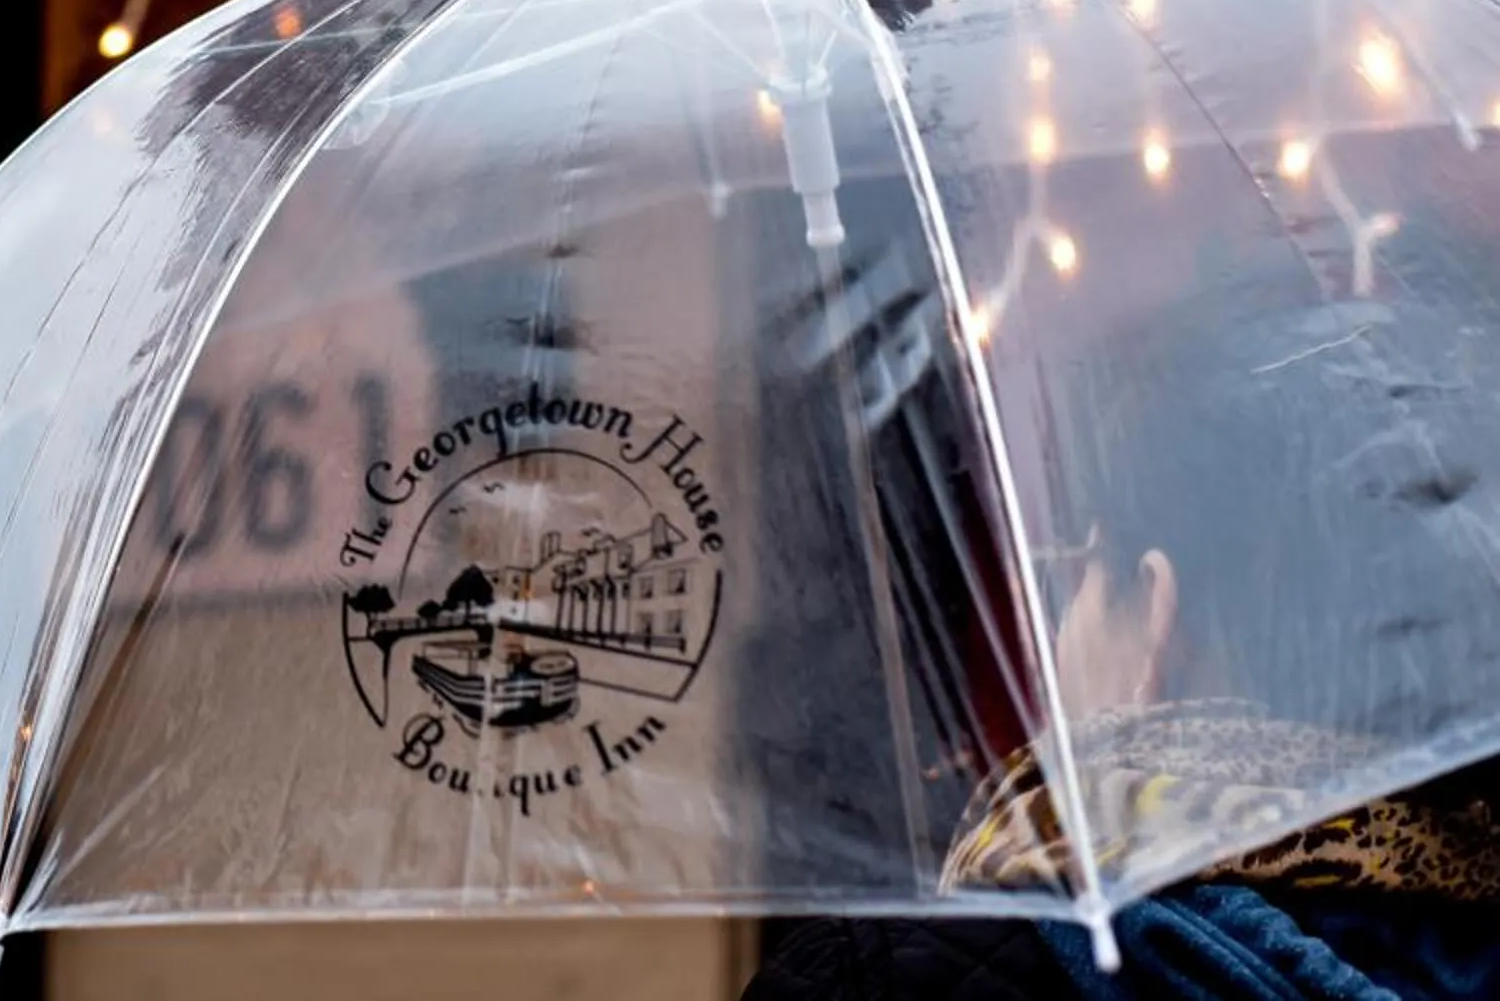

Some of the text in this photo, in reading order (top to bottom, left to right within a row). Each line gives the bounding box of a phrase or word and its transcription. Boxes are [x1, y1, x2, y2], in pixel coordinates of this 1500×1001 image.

[340, 382, 724, 567] The Georgetown House
[393, 712, 667, 817] Bouque Inn
